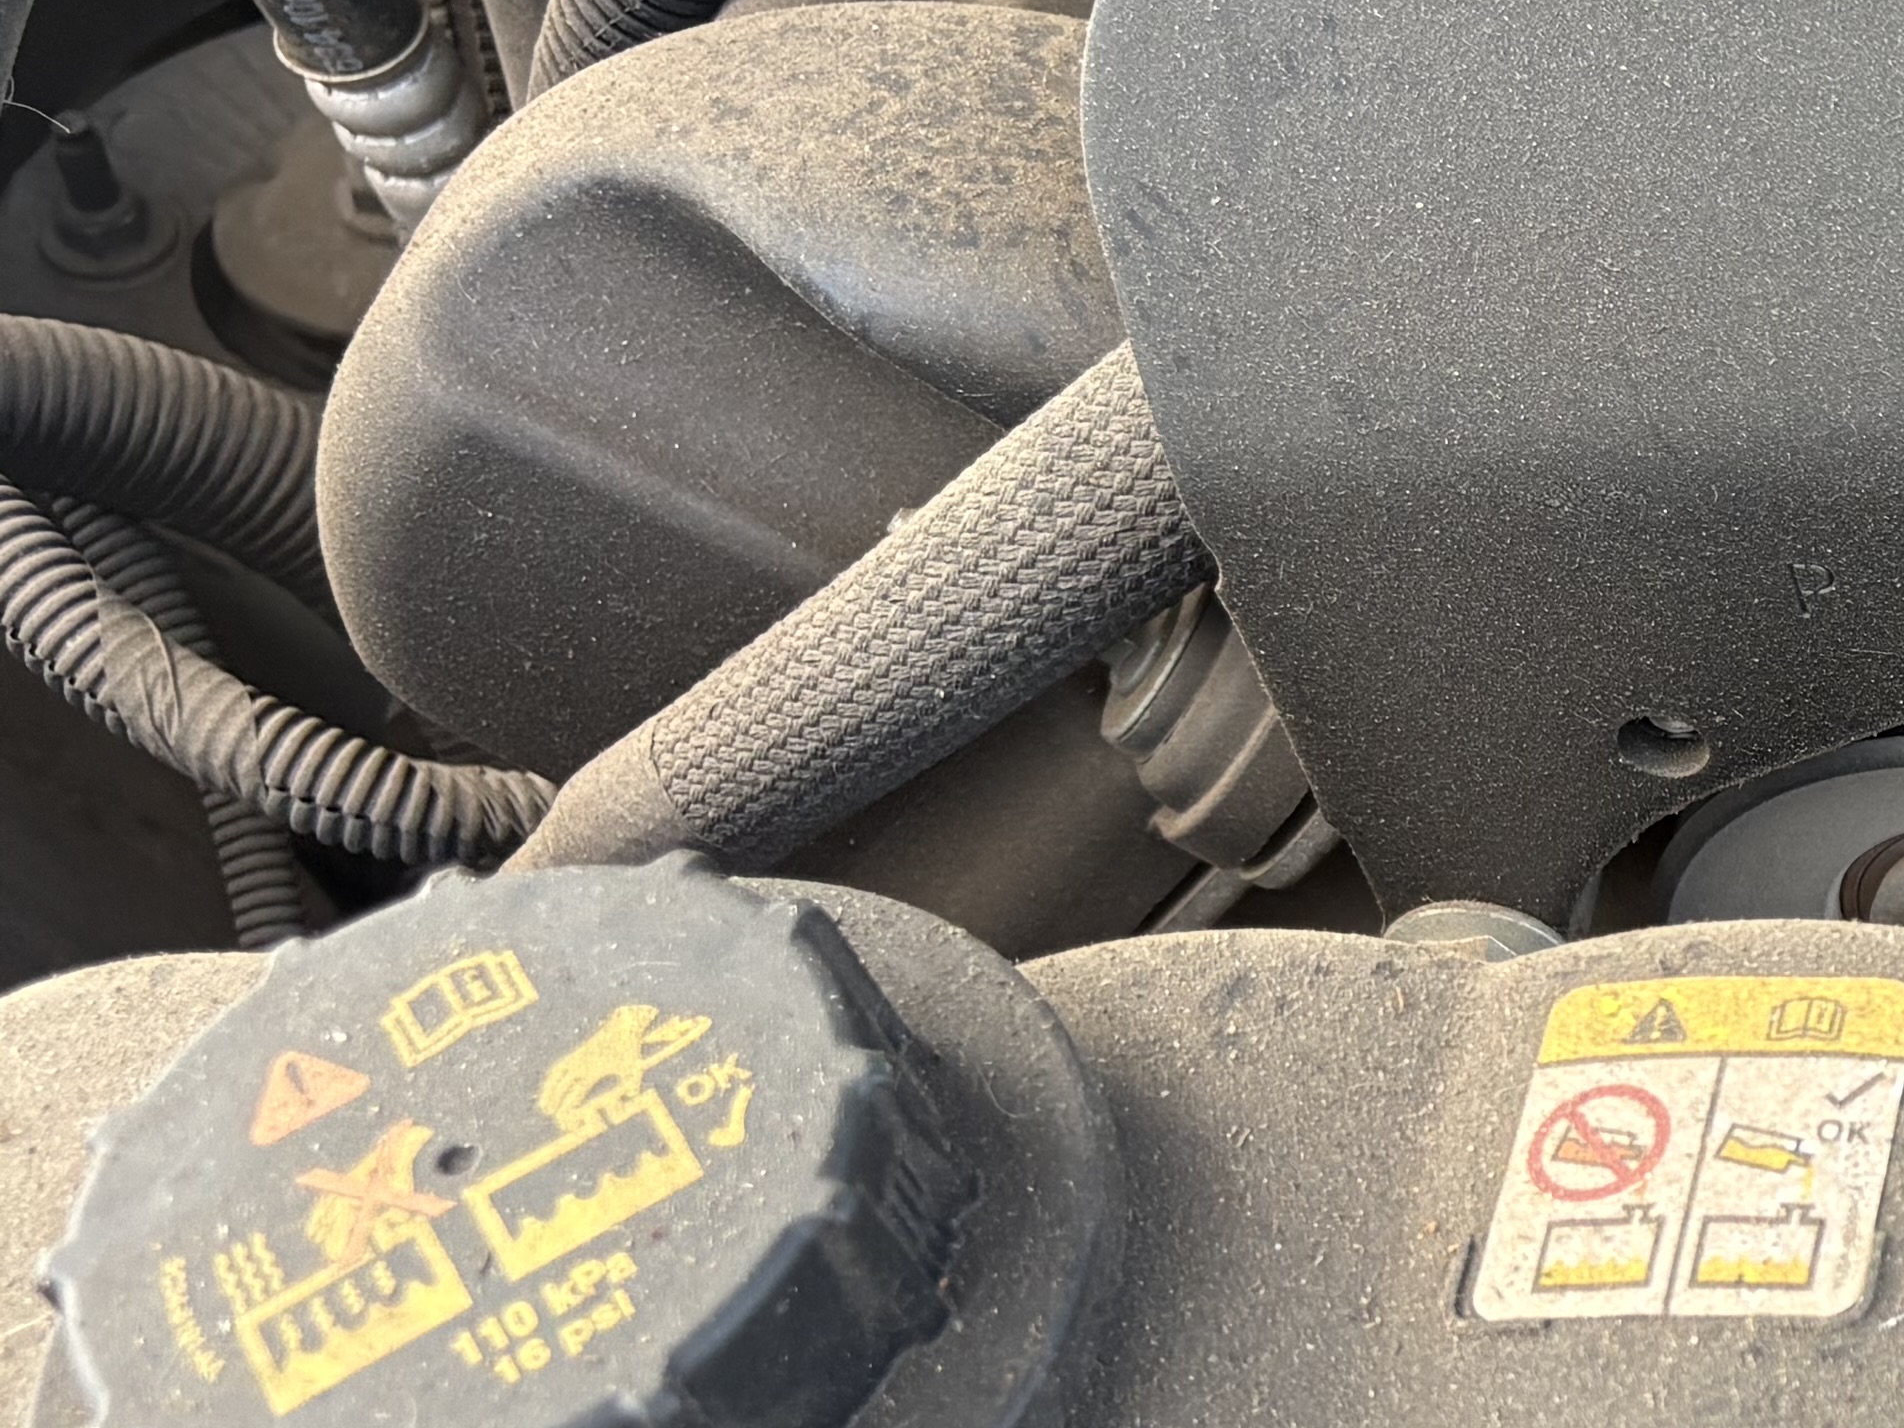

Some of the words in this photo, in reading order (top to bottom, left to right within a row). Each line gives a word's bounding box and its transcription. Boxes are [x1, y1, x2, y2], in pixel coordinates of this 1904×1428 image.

[674, 1051, 754, 1107] OK
[1816, 1118, 1871, 1145] OK
[451, 1301, 542, 1367] 110
[540, 1250, 639, 1317] kPa
[494, 1333, 553, 1384] 16
